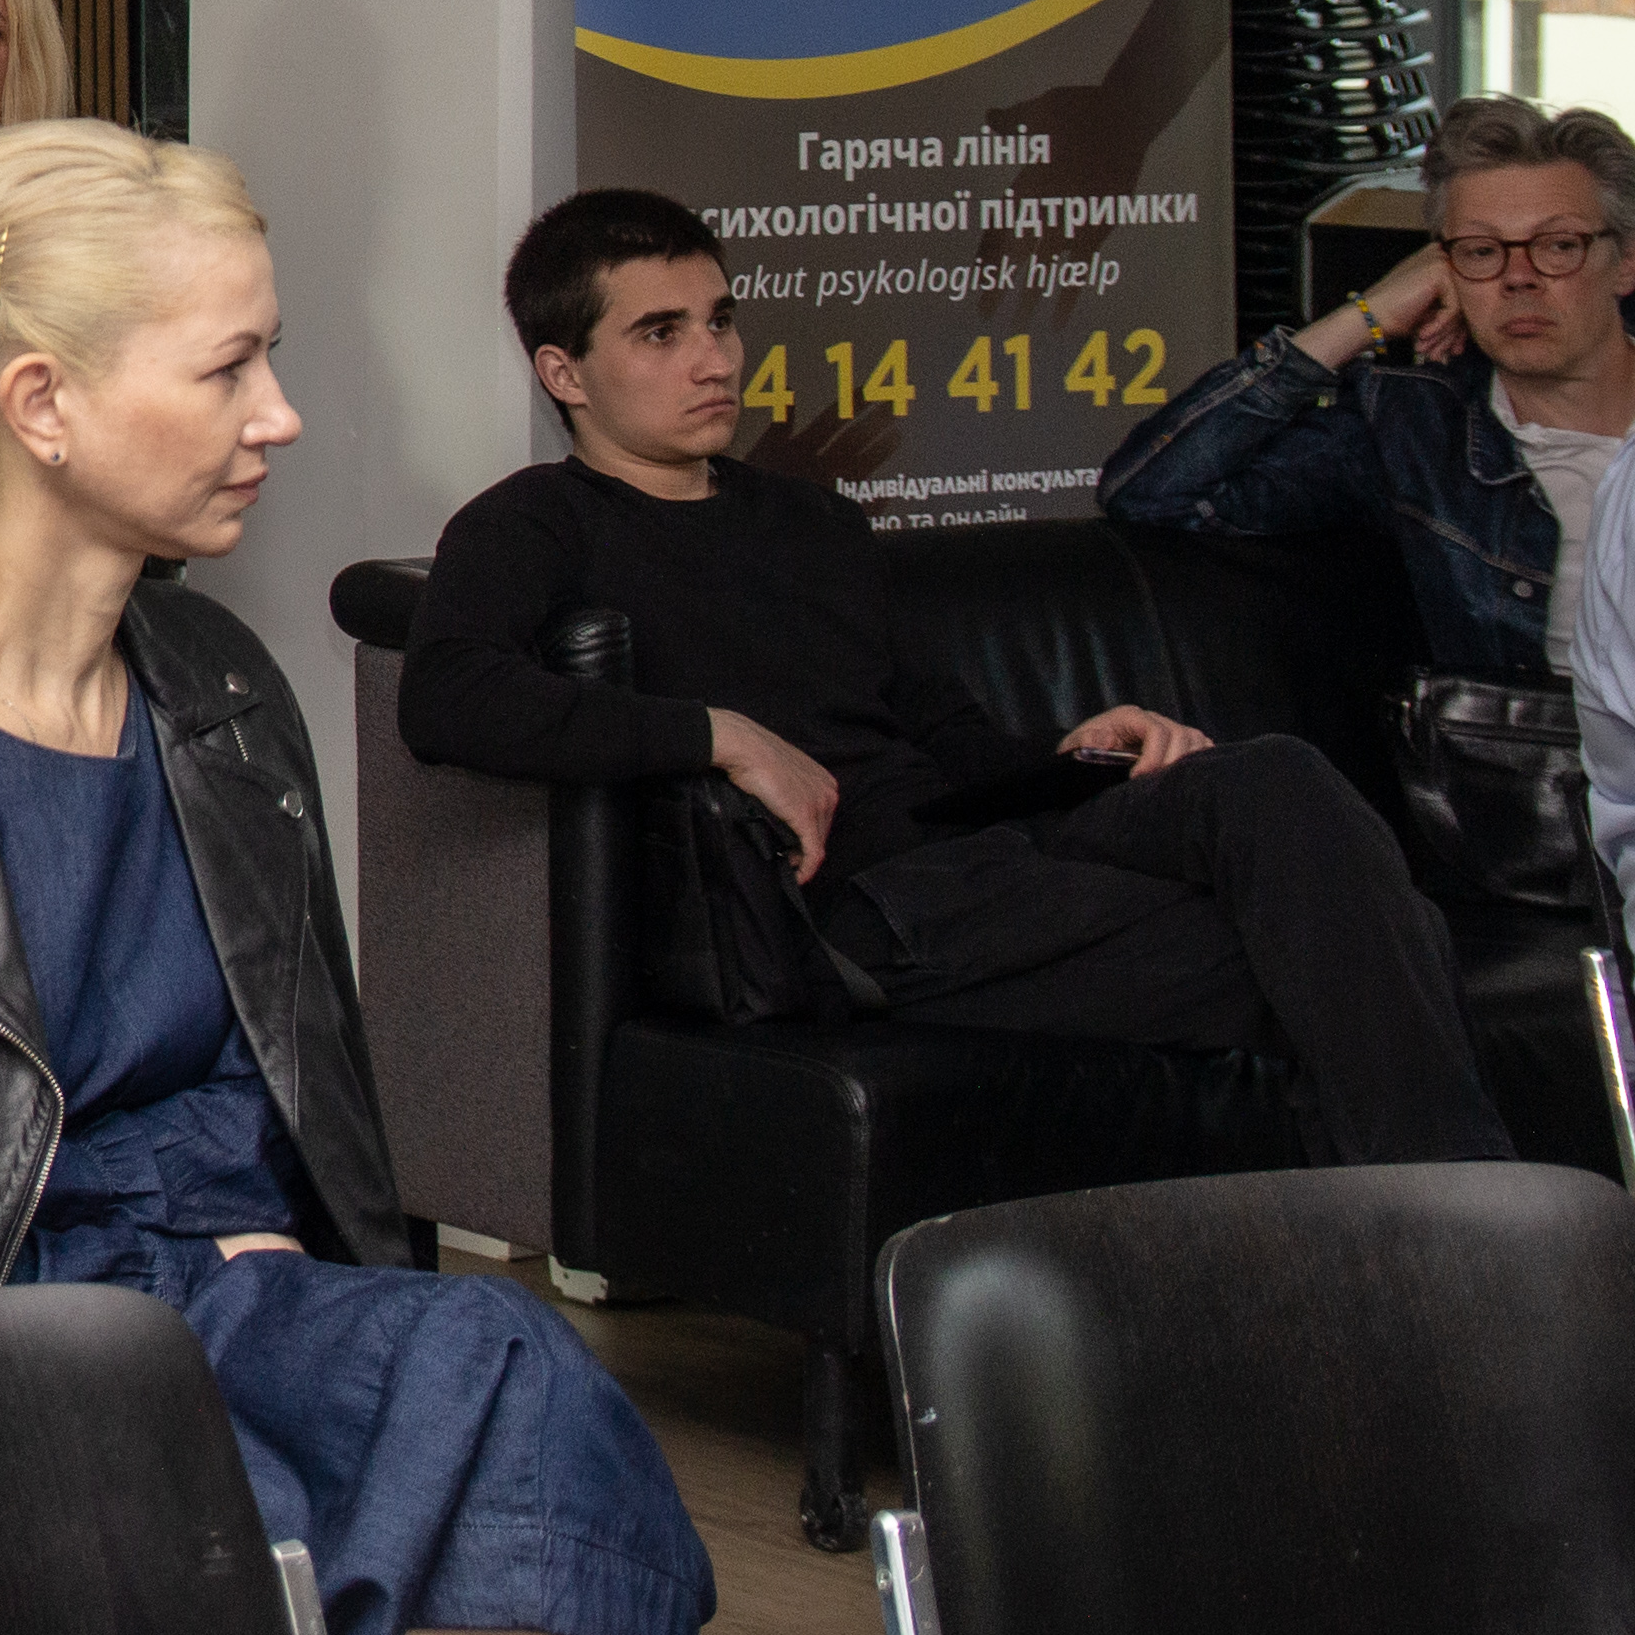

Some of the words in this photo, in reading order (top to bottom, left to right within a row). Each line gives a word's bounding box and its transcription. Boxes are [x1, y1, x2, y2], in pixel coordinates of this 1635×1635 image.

[798, 132, 944, 181] Гаряча
[953, 125, 1052, 168] лінія
[695, 189, 970, 241] сихологічної
[980, 189, 1199, 238] підтримки
[731, 264, 807, 300] akut
[816, 255, 1016, 307] psykologisk
[1025, 252, 1120, 297] hjælp
[742, 344, 795, 424] 4
[824, 339, 916, 419] 14
[947, 333, 1031, 413] 41
[1065, 328, 1168, 408] 42
